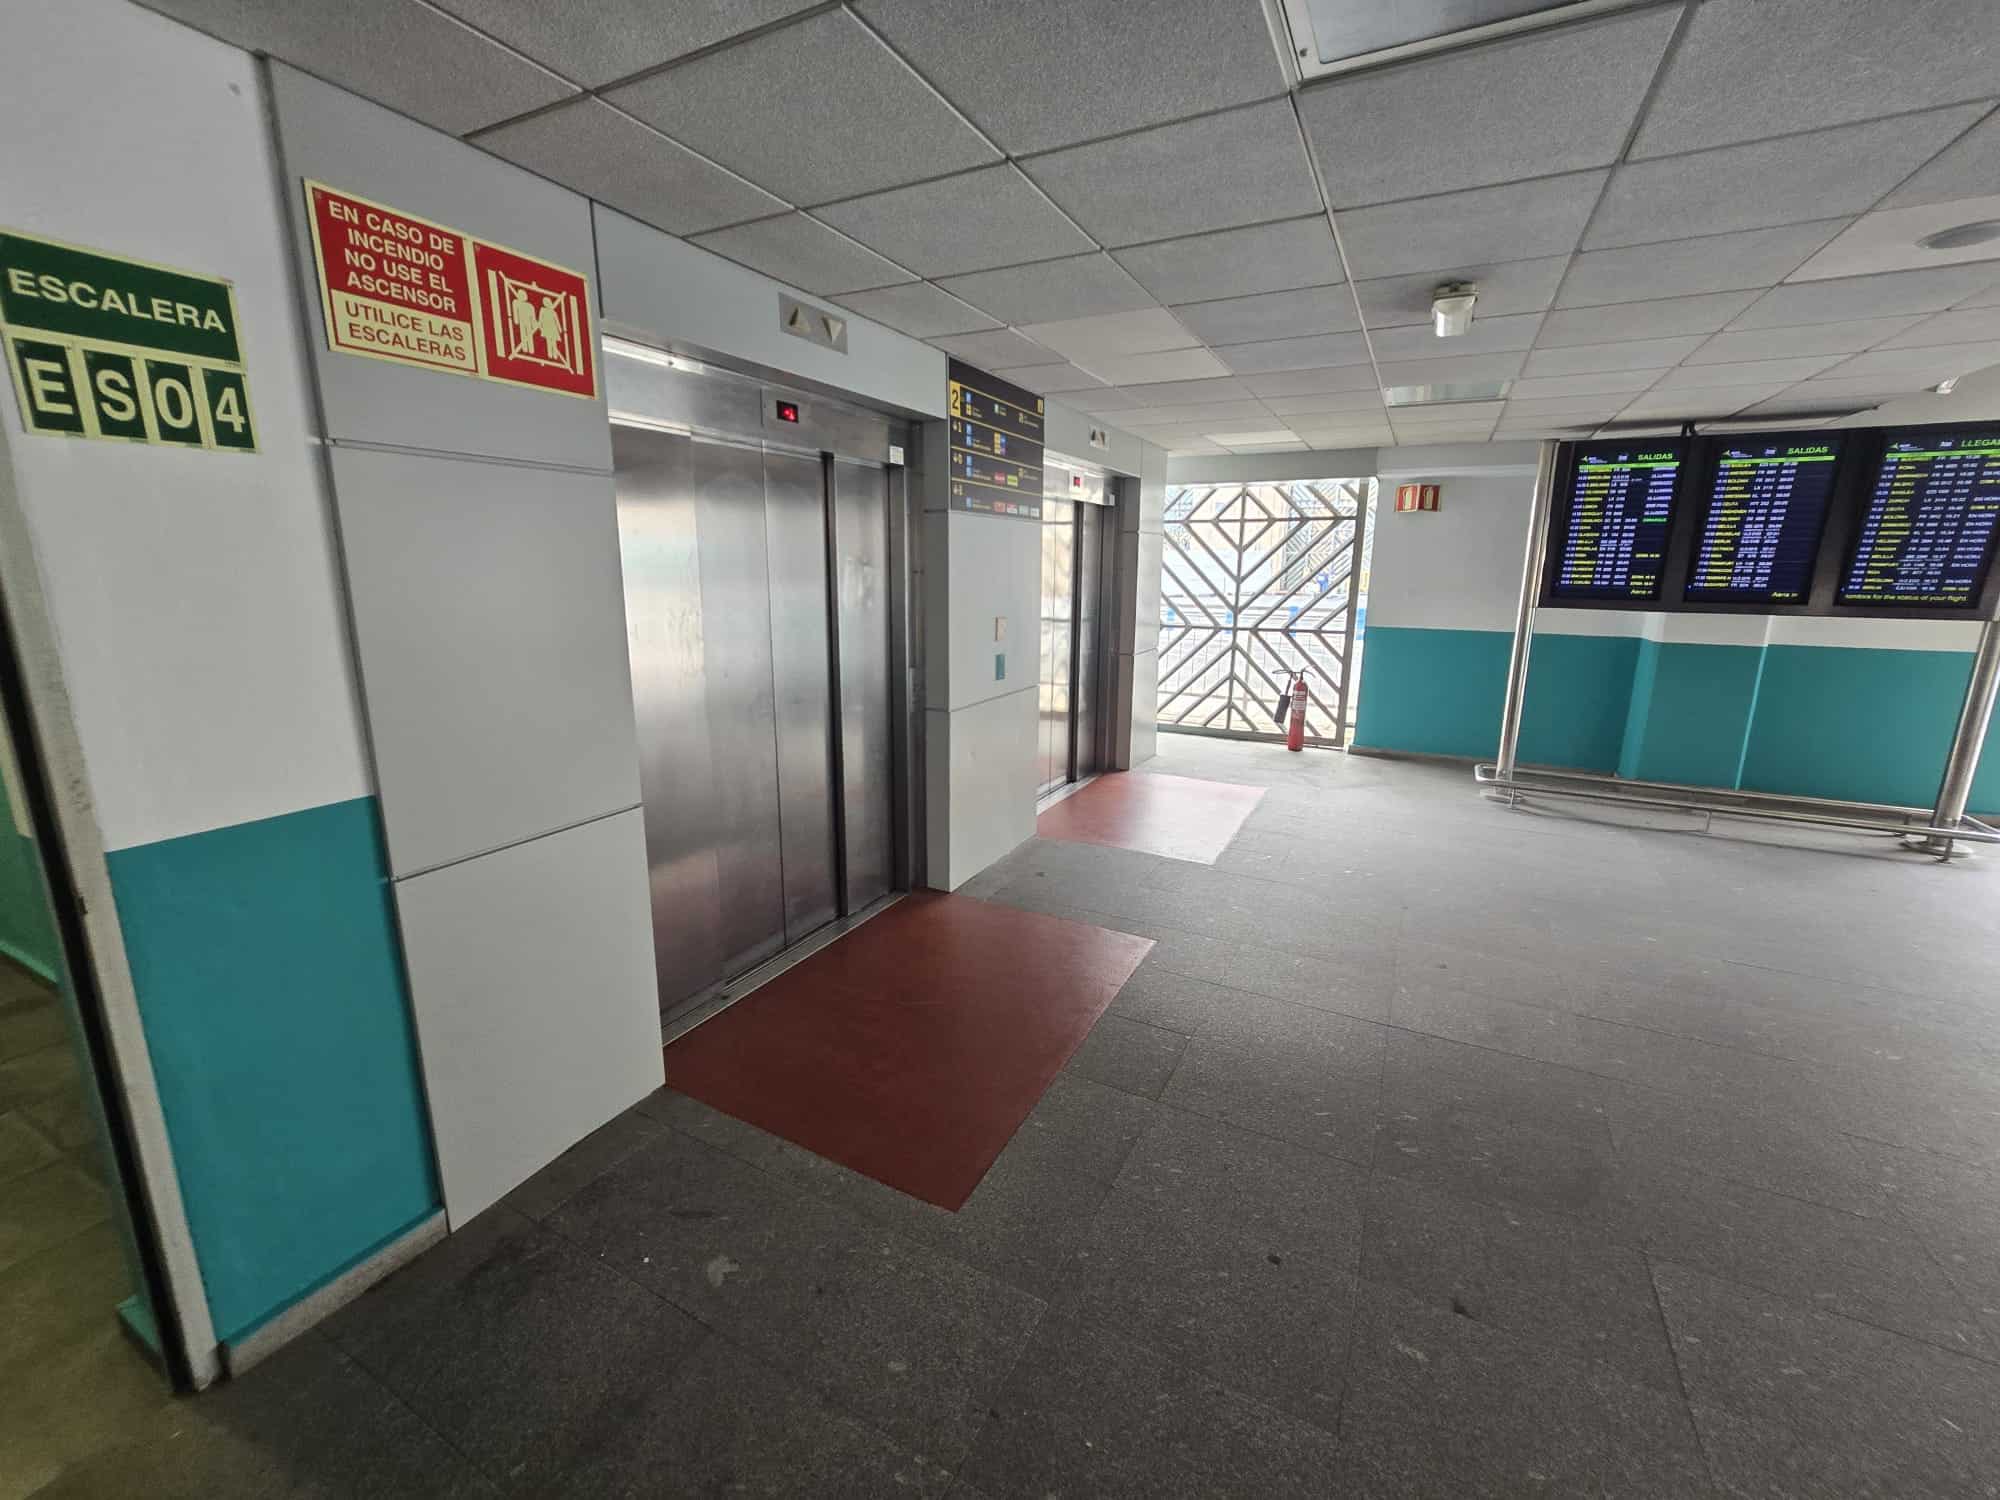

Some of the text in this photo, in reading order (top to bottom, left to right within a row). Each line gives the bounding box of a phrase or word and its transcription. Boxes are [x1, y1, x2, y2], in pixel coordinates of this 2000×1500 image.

[328, 200, 455, 255] EN CASO DE
[347, 228, 444, 271] INCENDIO
[344, 248, 454, 293] NO USE EL
[8, 267, 226, 333] ESCALERA
[347, 271, 456, 313] ASCENSOR
[345, 300, 464, 341] UTILICE LAS
[348, 322, 466, 361] ESCALERAS
[951, 389, 960, 411] 2
[1638, 453, 1673, 461] SALIDAS
[1787, 446, 1829, 455] SALIDAS
